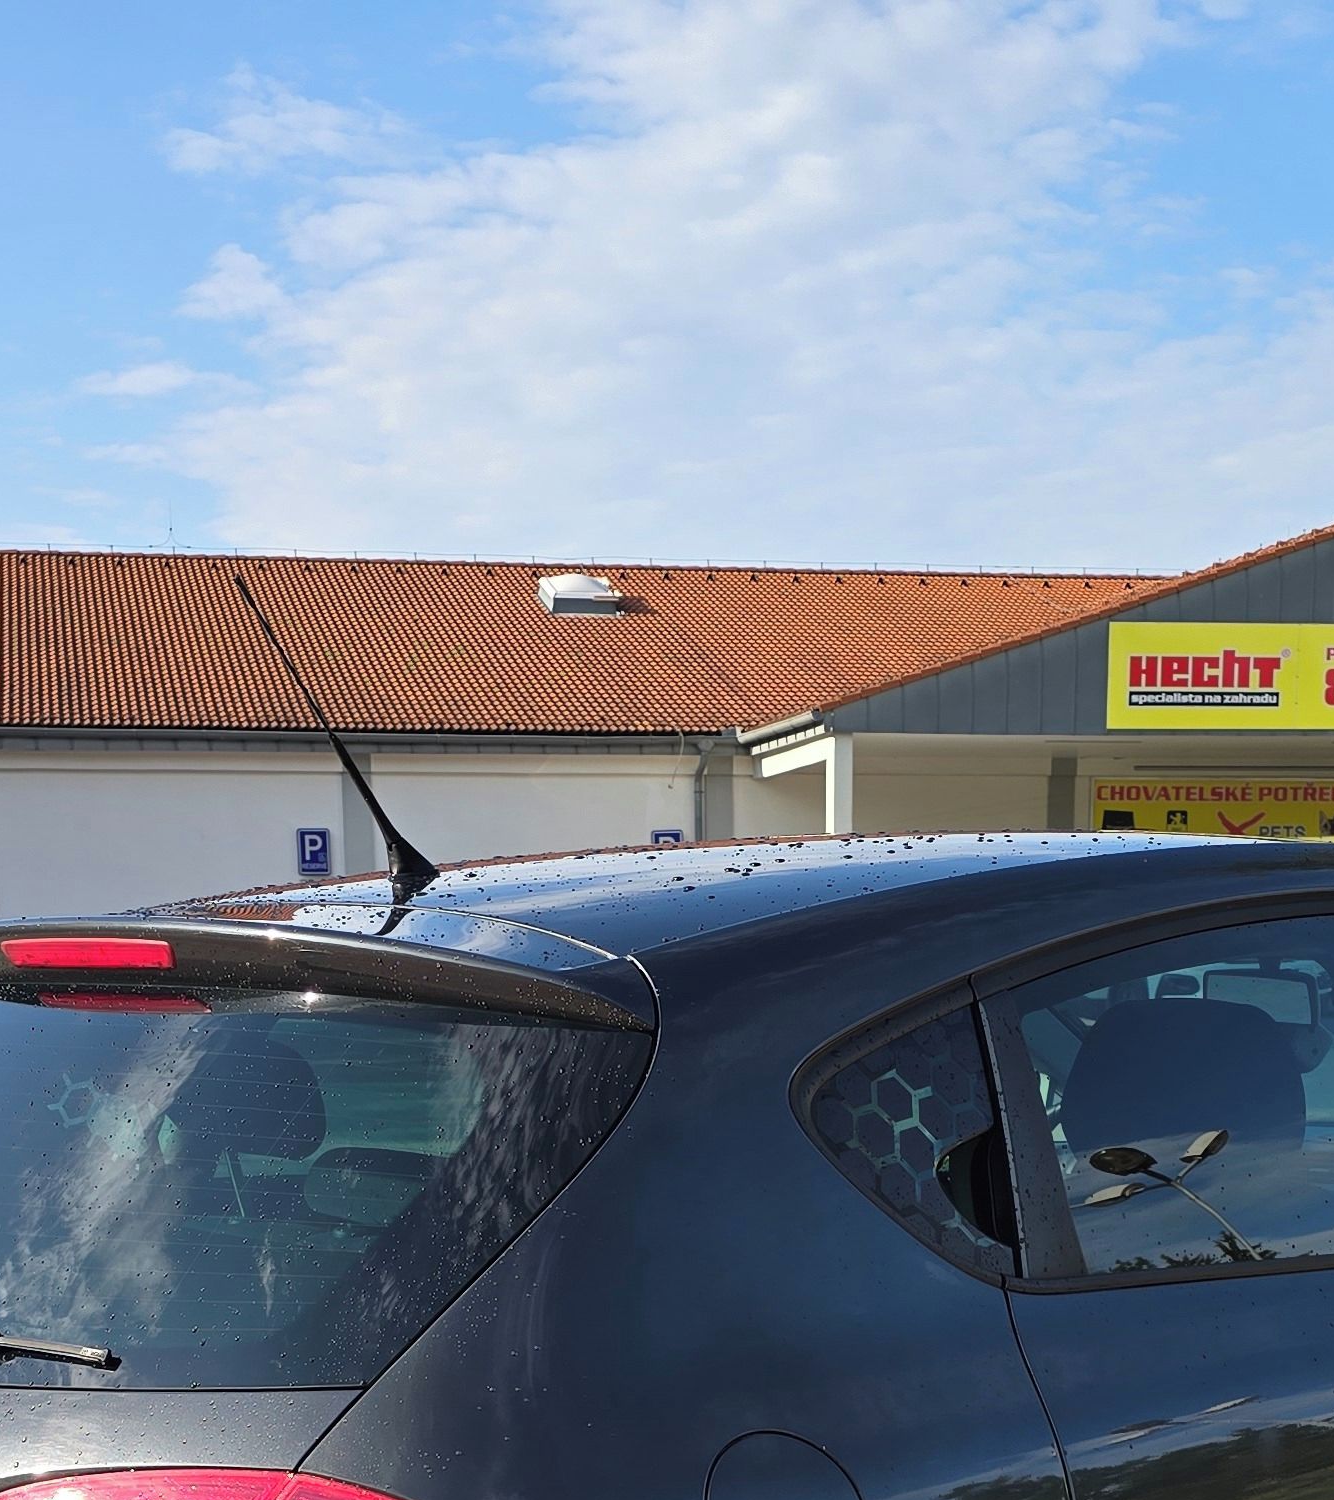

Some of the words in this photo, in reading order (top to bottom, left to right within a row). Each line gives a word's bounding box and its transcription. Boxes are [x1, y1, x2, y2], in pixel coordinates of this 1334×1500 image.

[1131, 693, 1203, 704] specialista
[1205, 695, 1222, 703] na
[1223, 693, 1277, 704] zahradu
[1096, 782, 1253, 801] CHOVATELSKÉ
[304, 834, 323, 860] P
